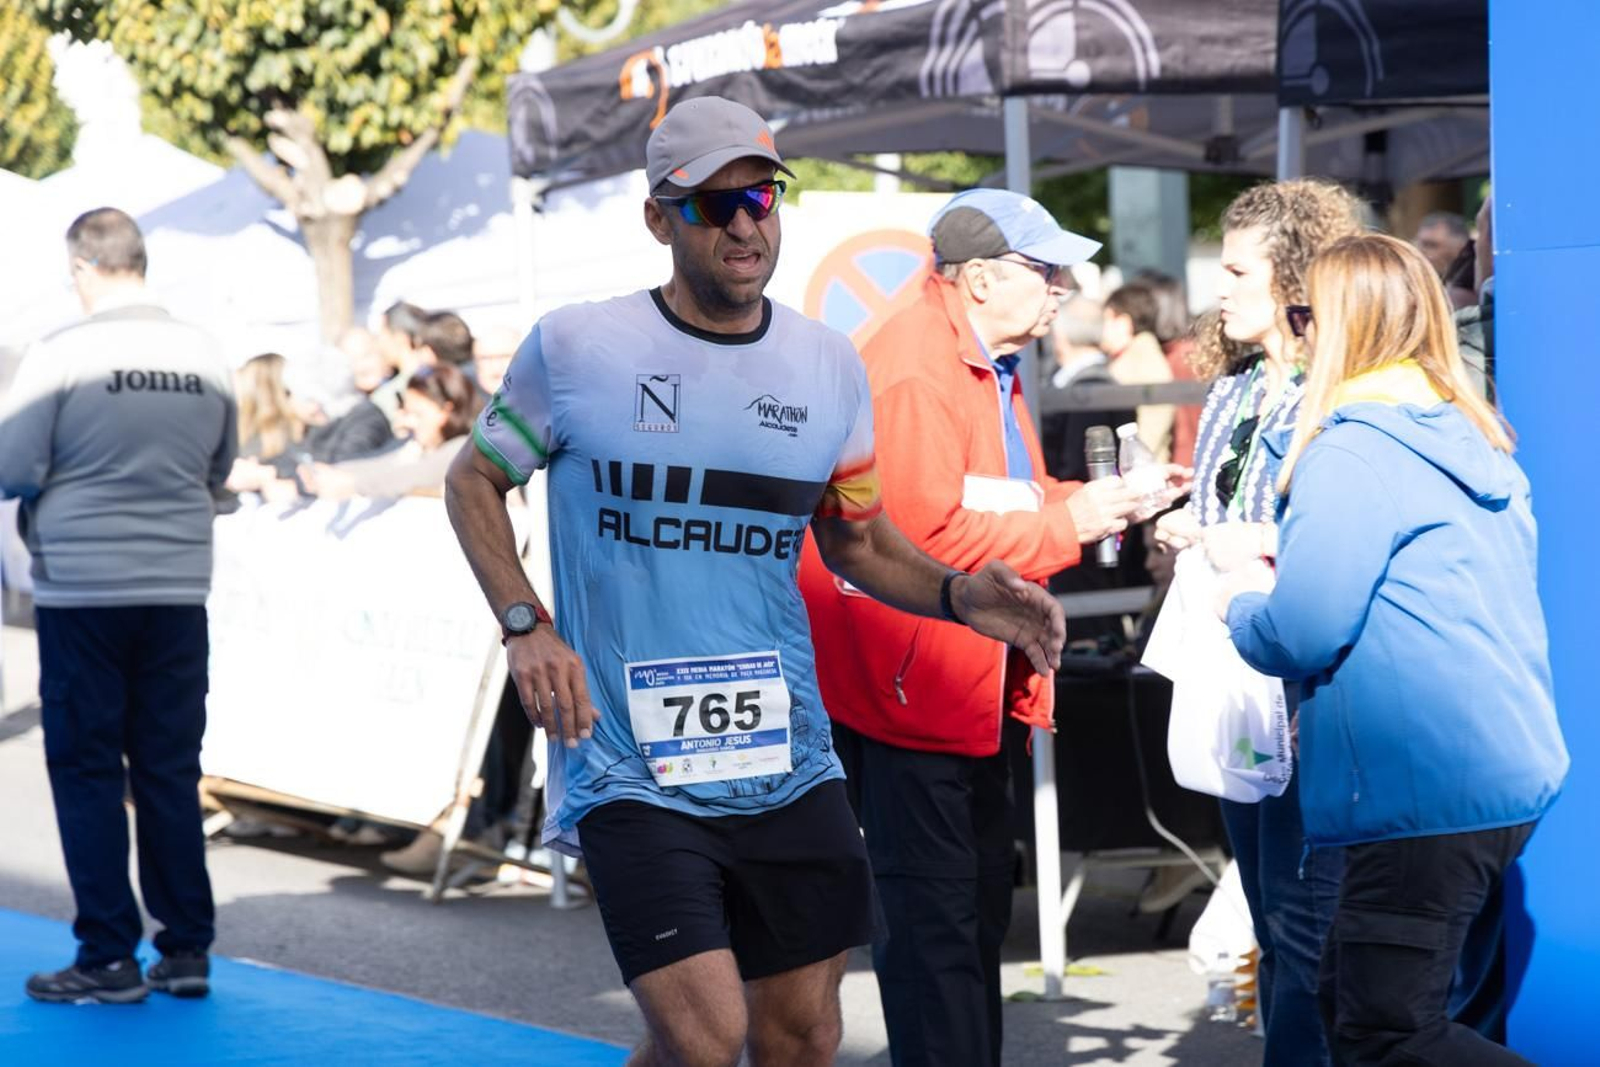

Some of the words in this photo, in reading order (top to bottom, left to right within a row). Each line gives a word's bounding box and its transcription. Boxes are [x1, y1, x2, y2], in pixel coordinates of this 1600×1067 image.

[106, 369, 204, 396] Joma
[638, 375, 680, 423] Ñ
[663, 691, 761, 738] 765
[681, 739, 721, 750] ANTONIO
[724, 735, 752, 747] JESUS
